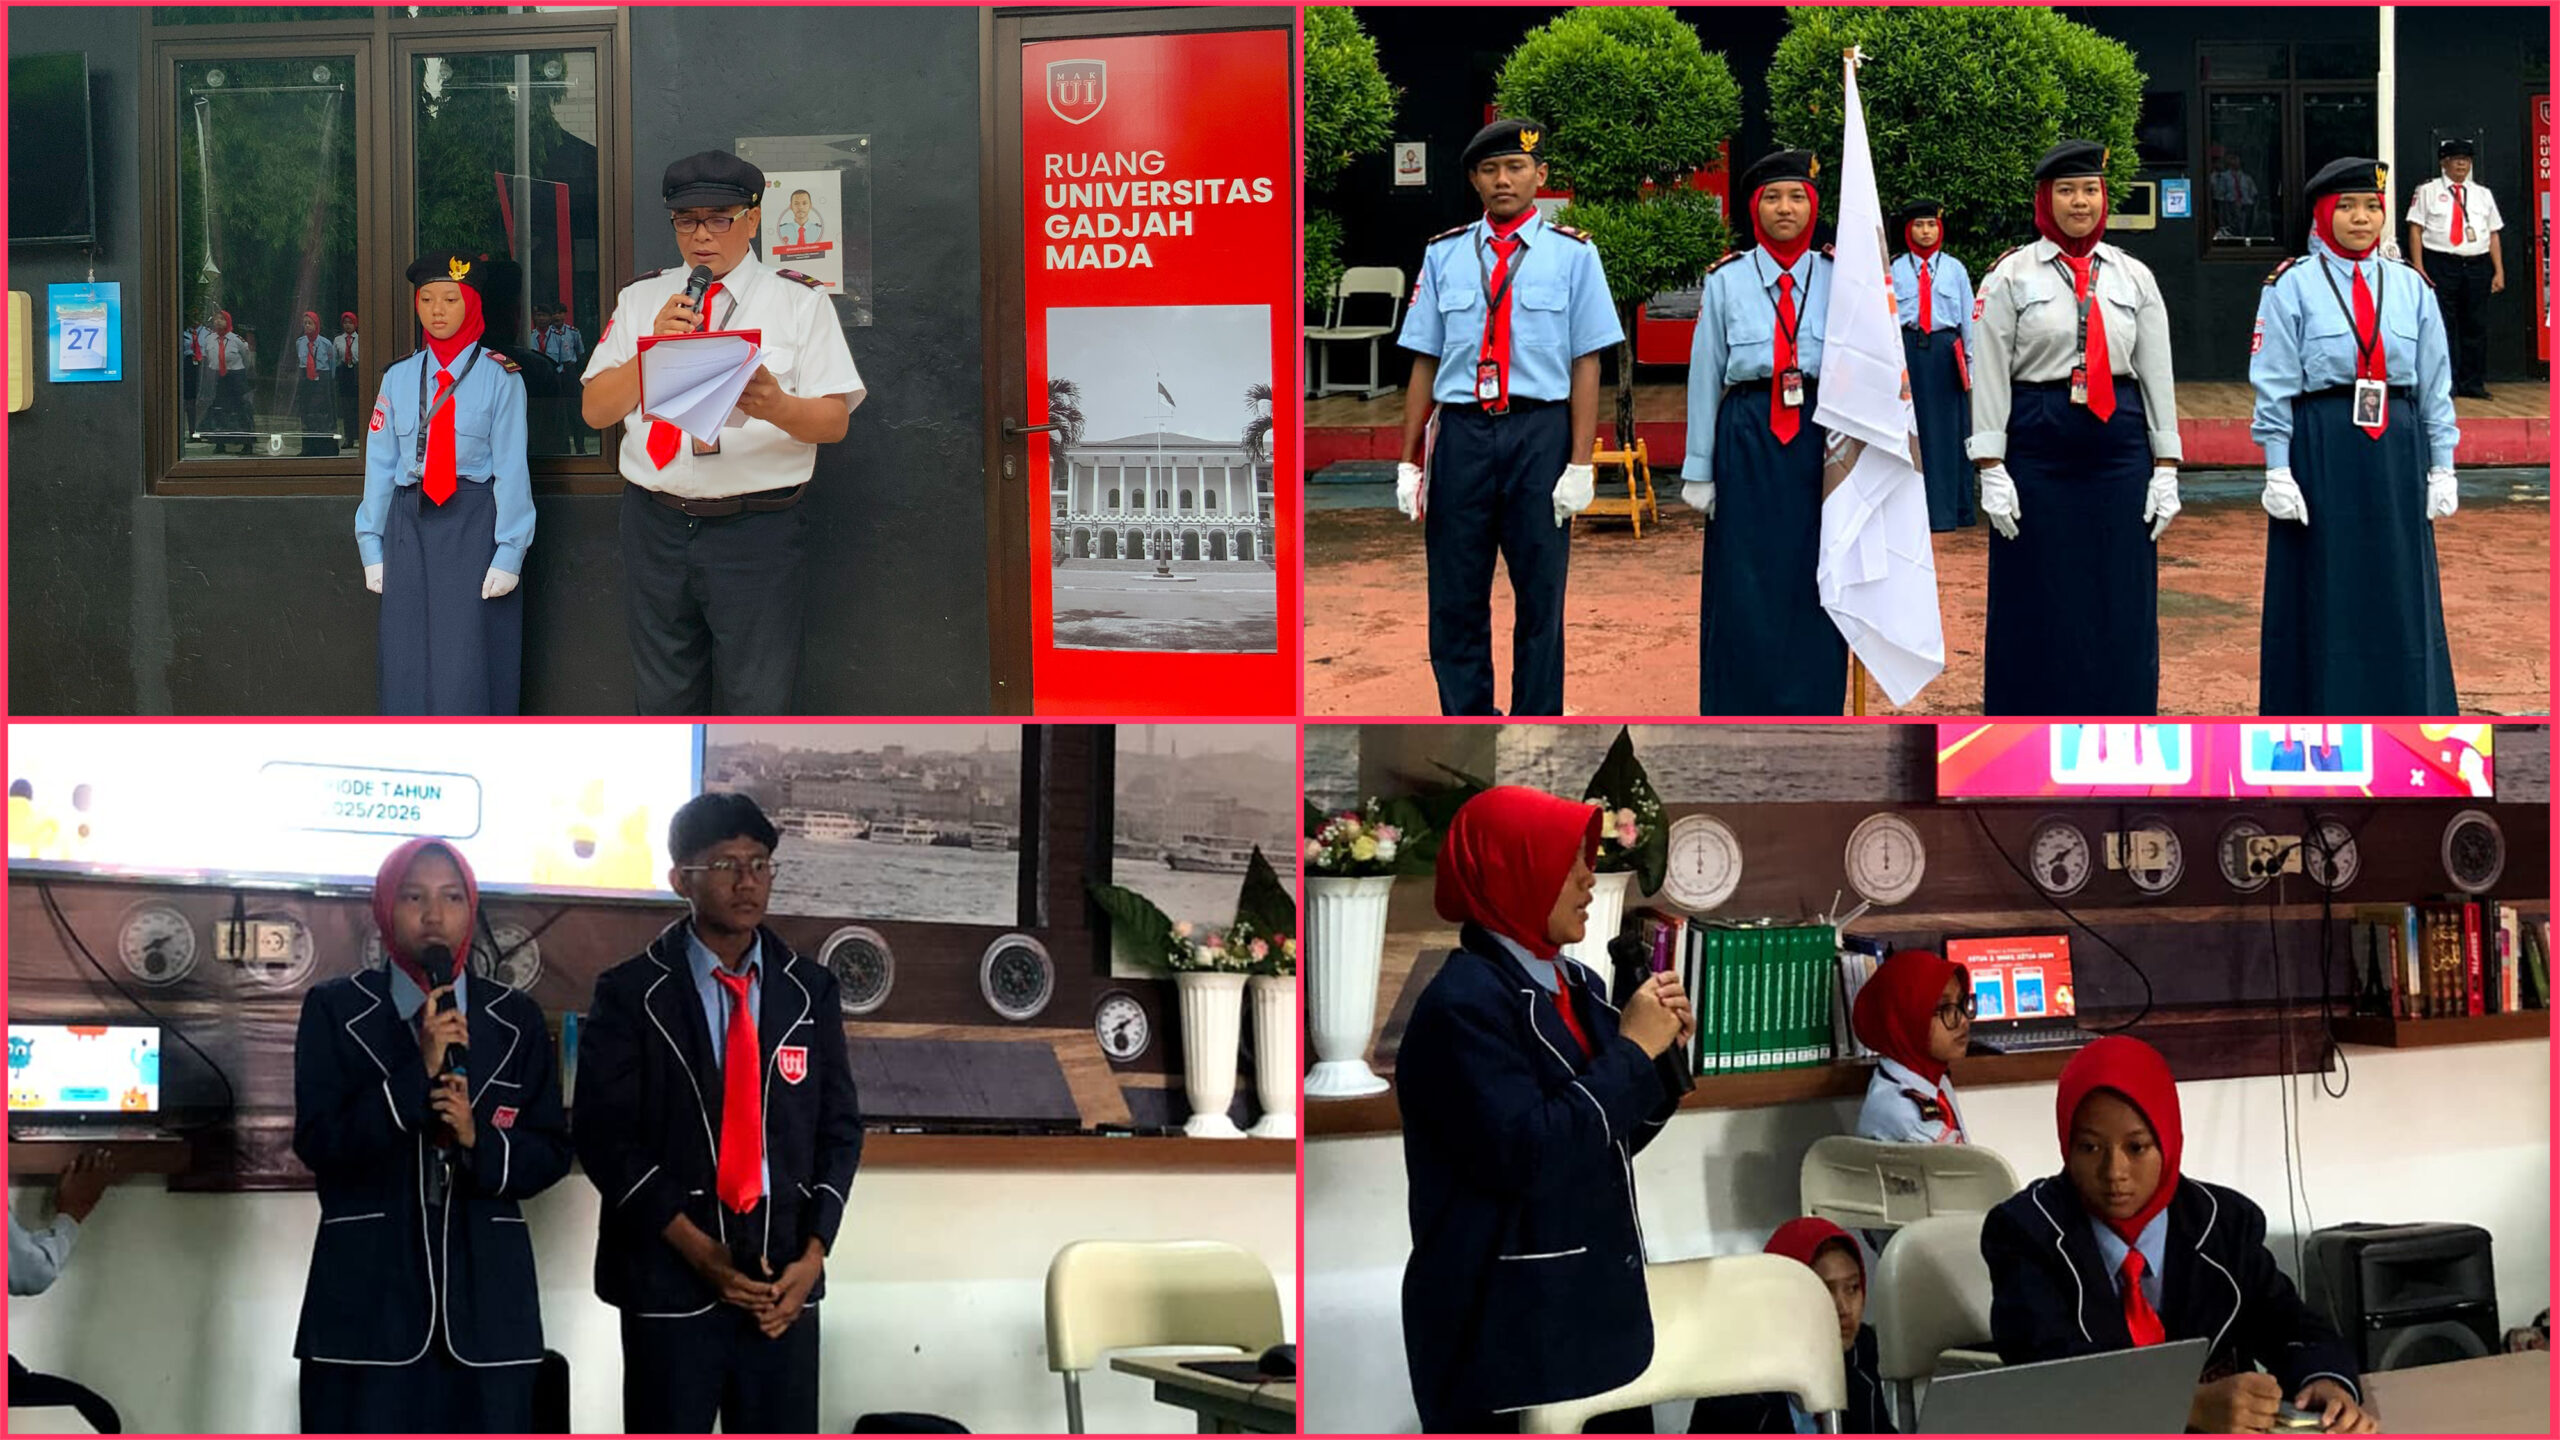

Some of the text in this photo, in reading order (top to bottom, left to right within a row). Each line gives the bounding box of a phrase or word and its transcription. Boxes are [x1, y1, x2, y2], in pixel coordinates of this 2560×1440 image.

[1056, 71, 1096, 81] MAK
[1056, 80, 1097, 105] UI
[1045, 150, 1165, 178] RUANG
[1044, 177, 1273, 209] UNIVERSITAS
[2170, 195, 2184, 206] 27
[1044, 211, 1193, 239] GADJAH
[1045, 243, 1154, 270] MADA
[67, 328, 99, 350] 27
[326, 779, 442, 800] IODE TAHUN
[323, 801, 421, 821] 025/2026
